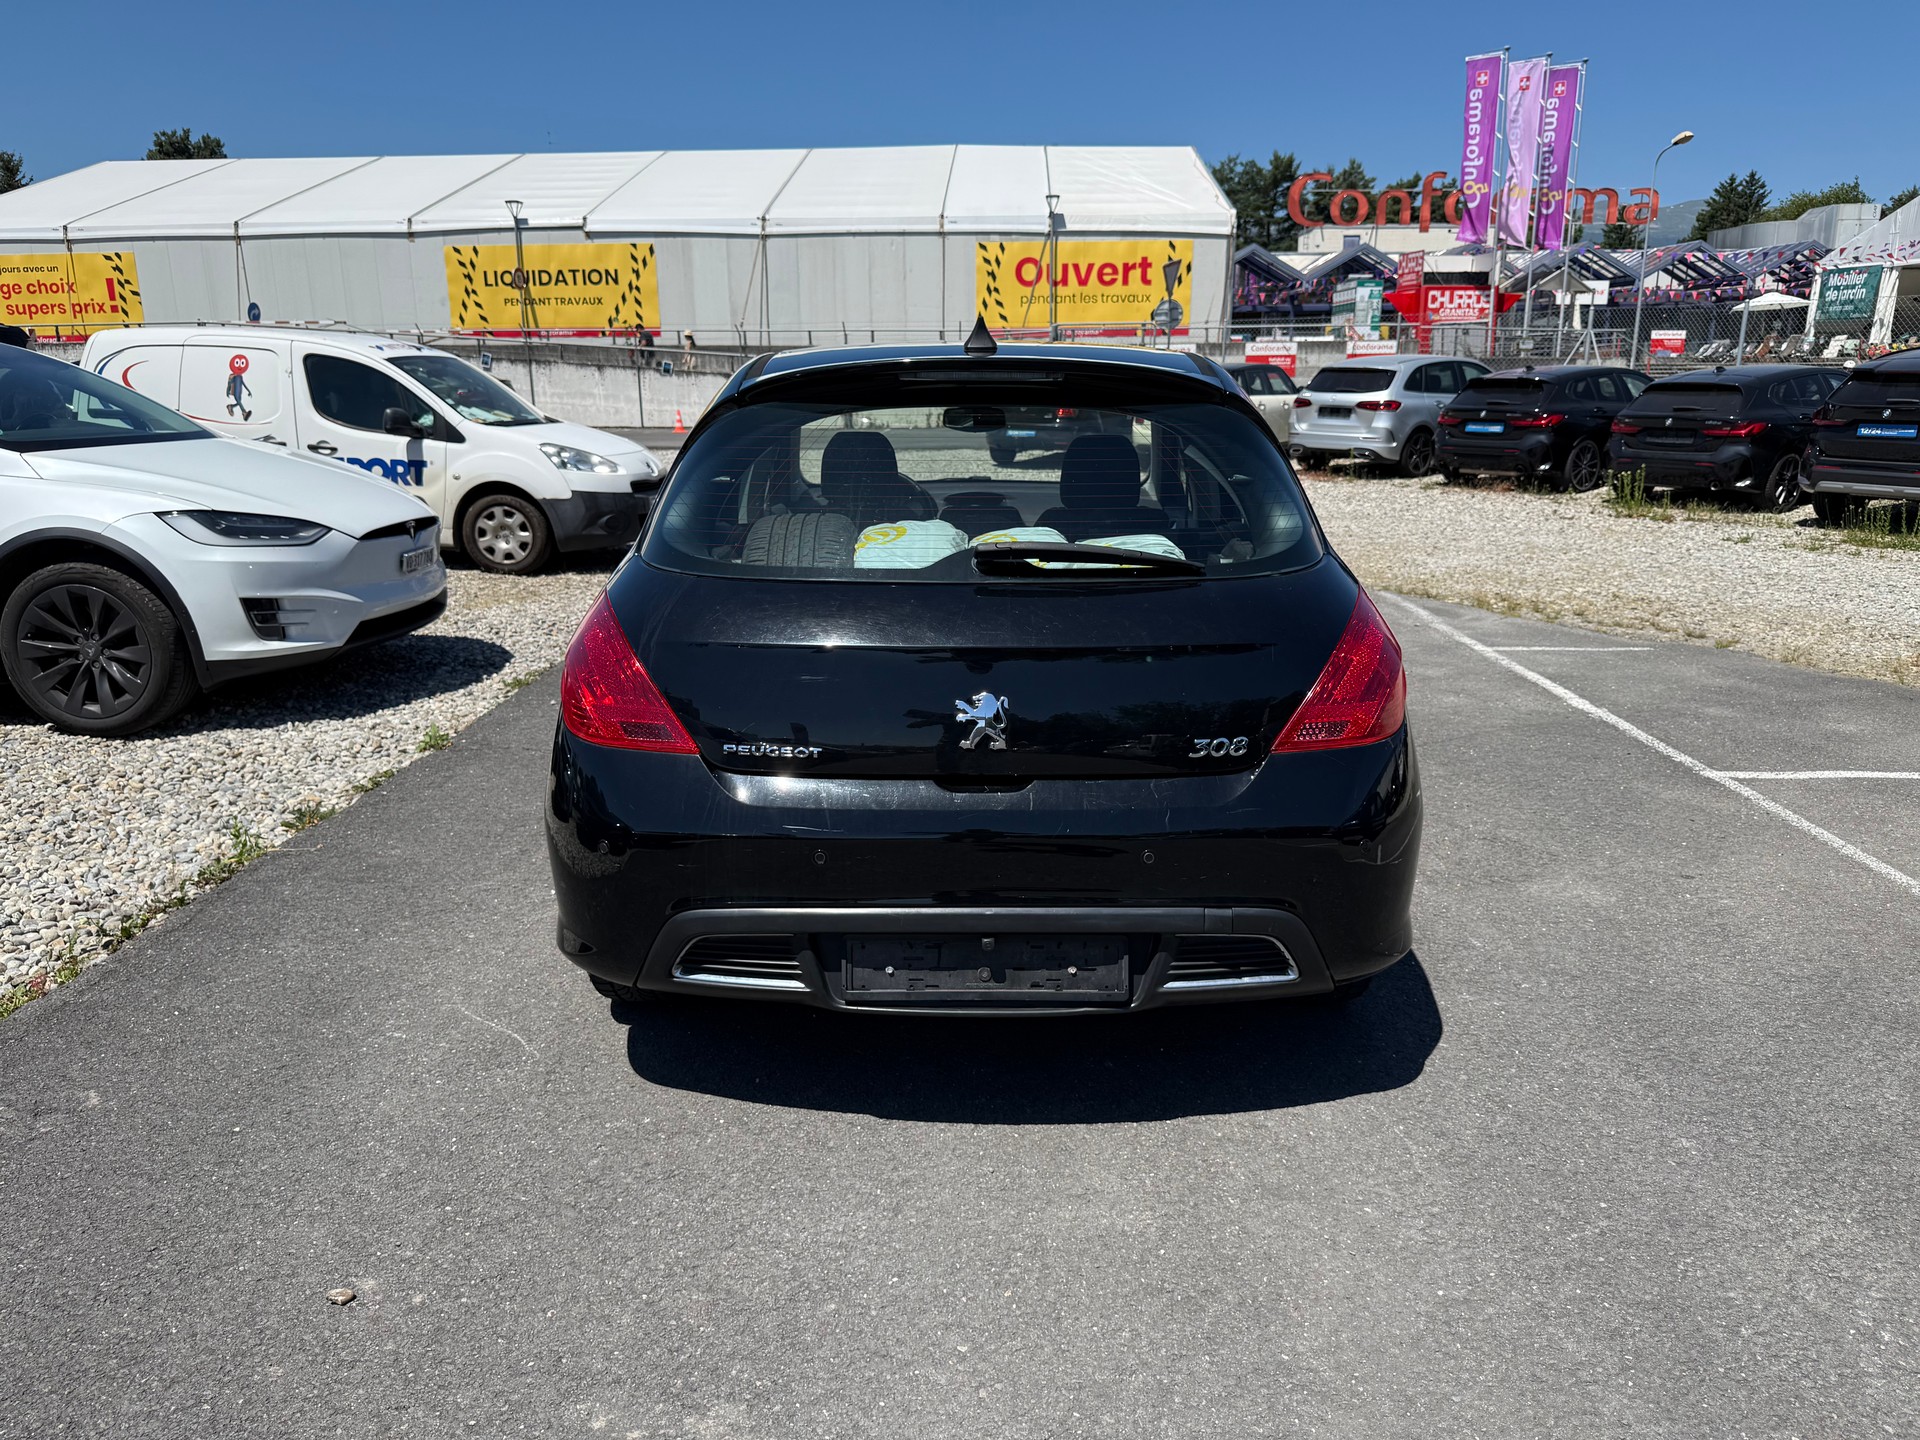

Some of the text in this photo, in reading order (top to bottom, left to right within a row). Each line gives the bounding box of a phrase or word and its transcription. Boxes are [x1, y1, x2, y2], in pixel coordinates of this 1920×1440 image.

[1288, 171, 1660, 233] Confma
[1015, 256, 1152, 288] Ouvert
[1828, 270, 1868, 286] Mobilier
[0, 278, 77, 300] ge choix
[1428, 290, 1491, 308] CHURROS
[1826, 285, 1866, 305] de jardin
[6, 301, 67, 320] supers
[72, 298, 107, 319] prix
[504, 296, 603, 306] PENDANT TRAVAUX
[1020, 293, 1151, 307] pendant les travaux
[723, 743, 822, 758] PEUGEOT
[1188, 736, 1248, 758] 308
